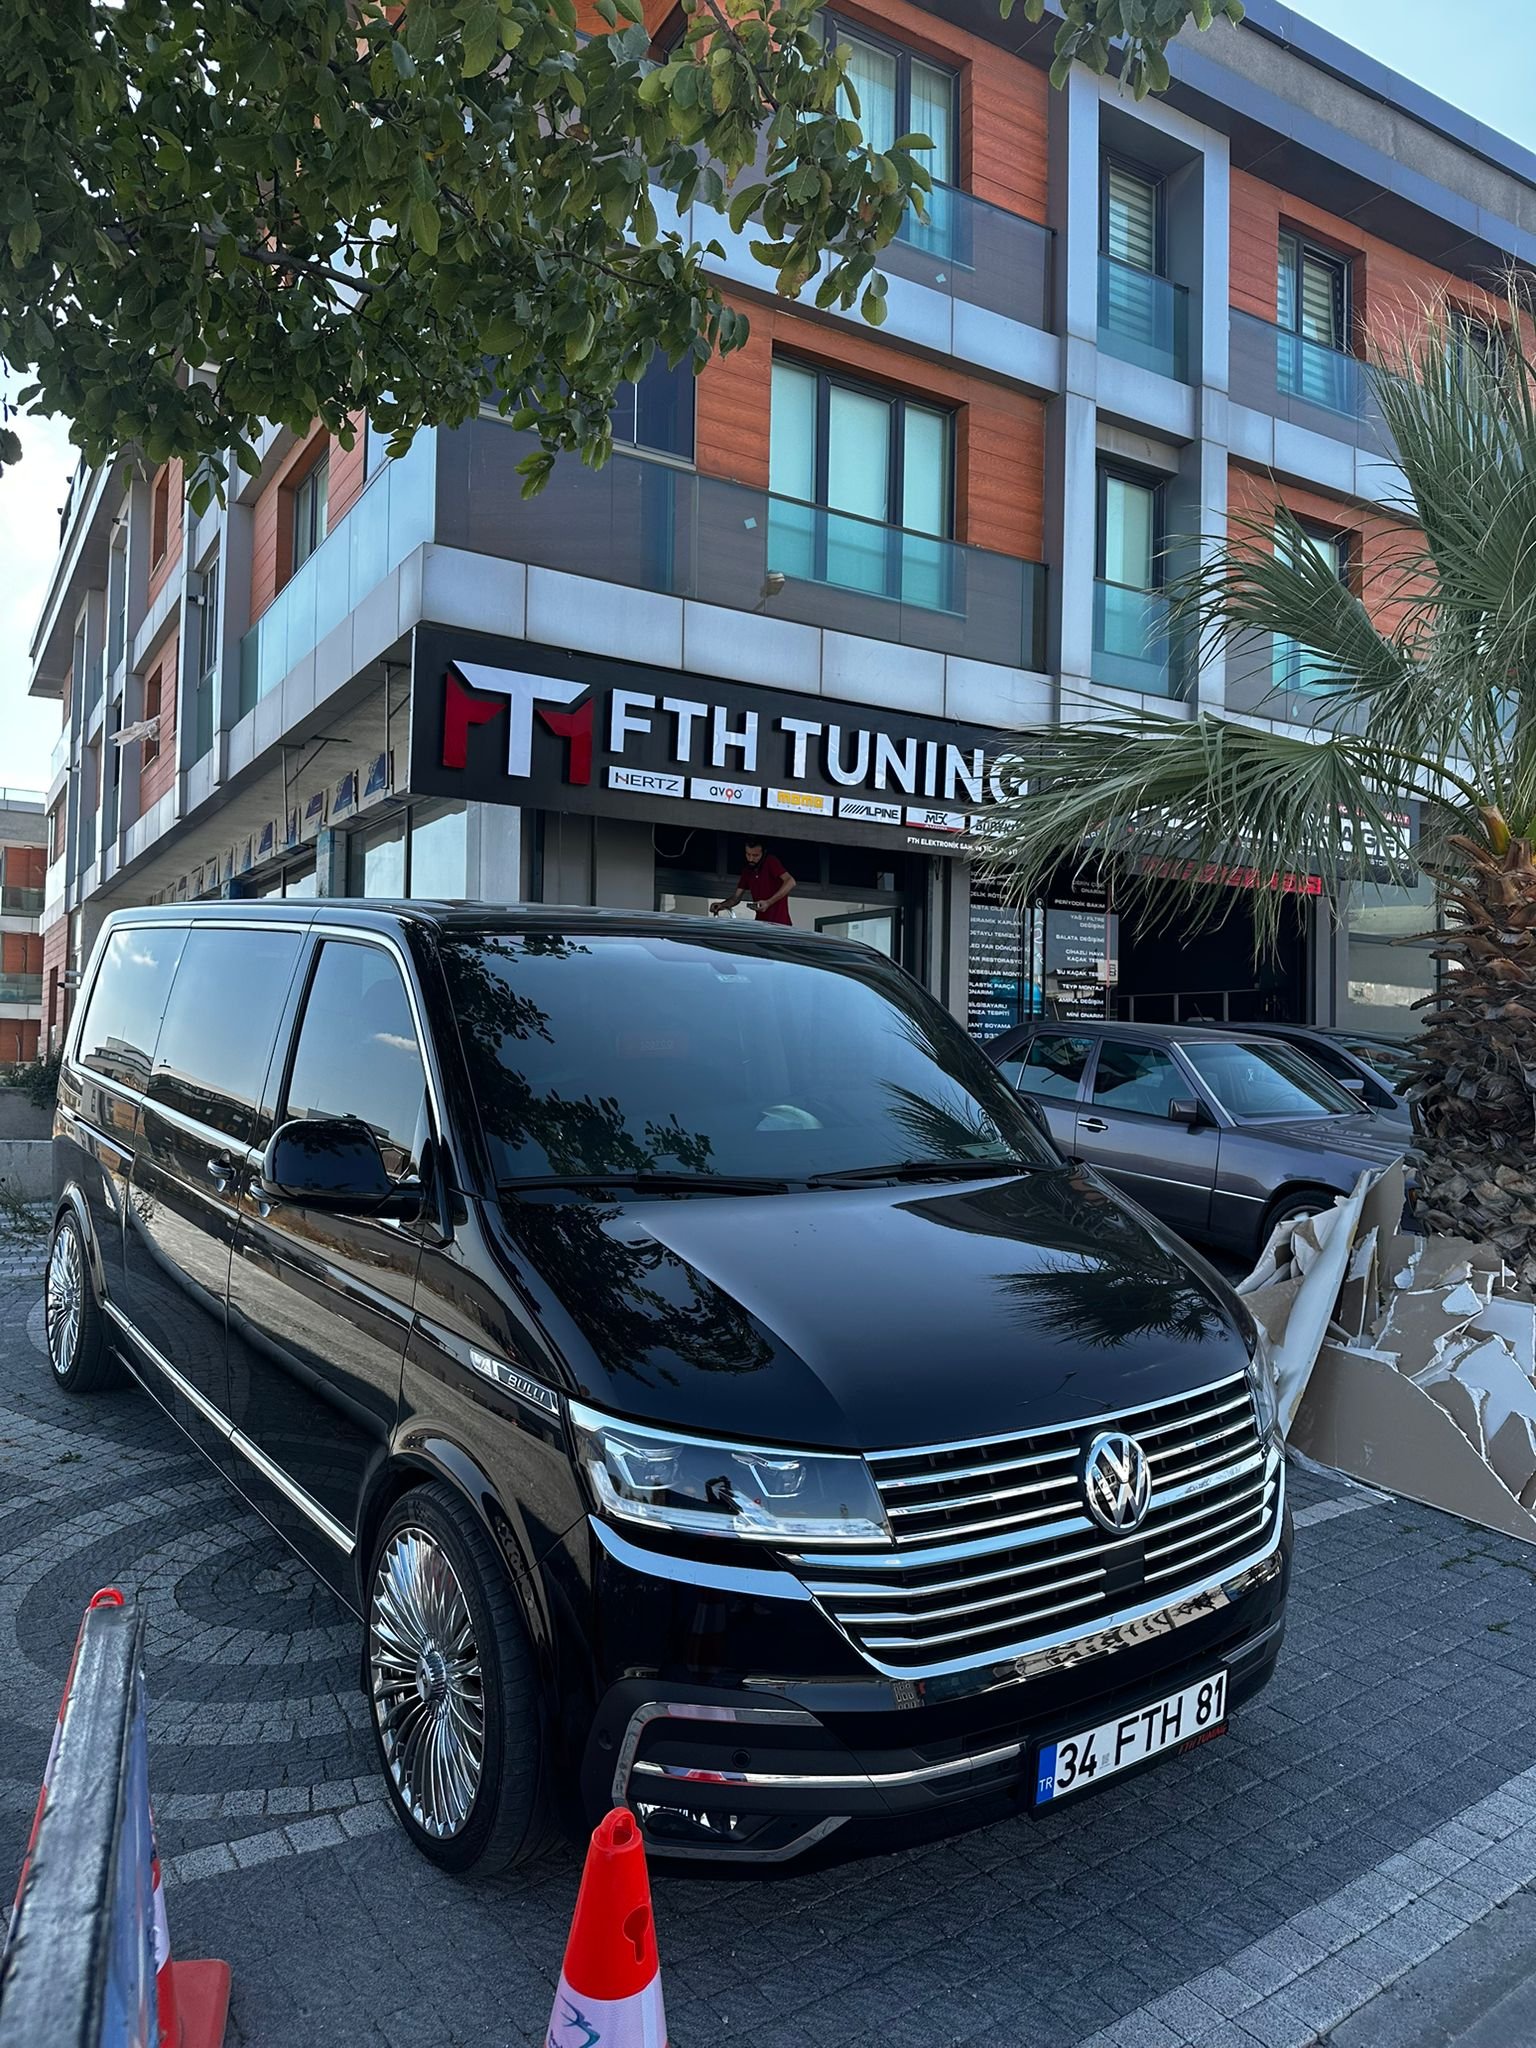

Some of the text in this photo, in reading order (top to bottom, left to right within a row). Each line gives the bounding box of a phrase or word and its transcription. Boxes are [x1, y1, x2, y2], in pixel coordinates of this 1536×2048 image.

[610, 688, 1029, 809] FTH TUNING
[615, 772, 679, 792] HERTZ
[856, 805, 899, 820] ALPINE
[907, 837, 920, 845] FTH
[981, 956, 1024, 965] RESTORASYO
[507, 1374, 545, 1402] BULLI
[1057, 1675, 1224, 1789] 34 FTH 81
[1039, 1776, 1053, 1792] TR
